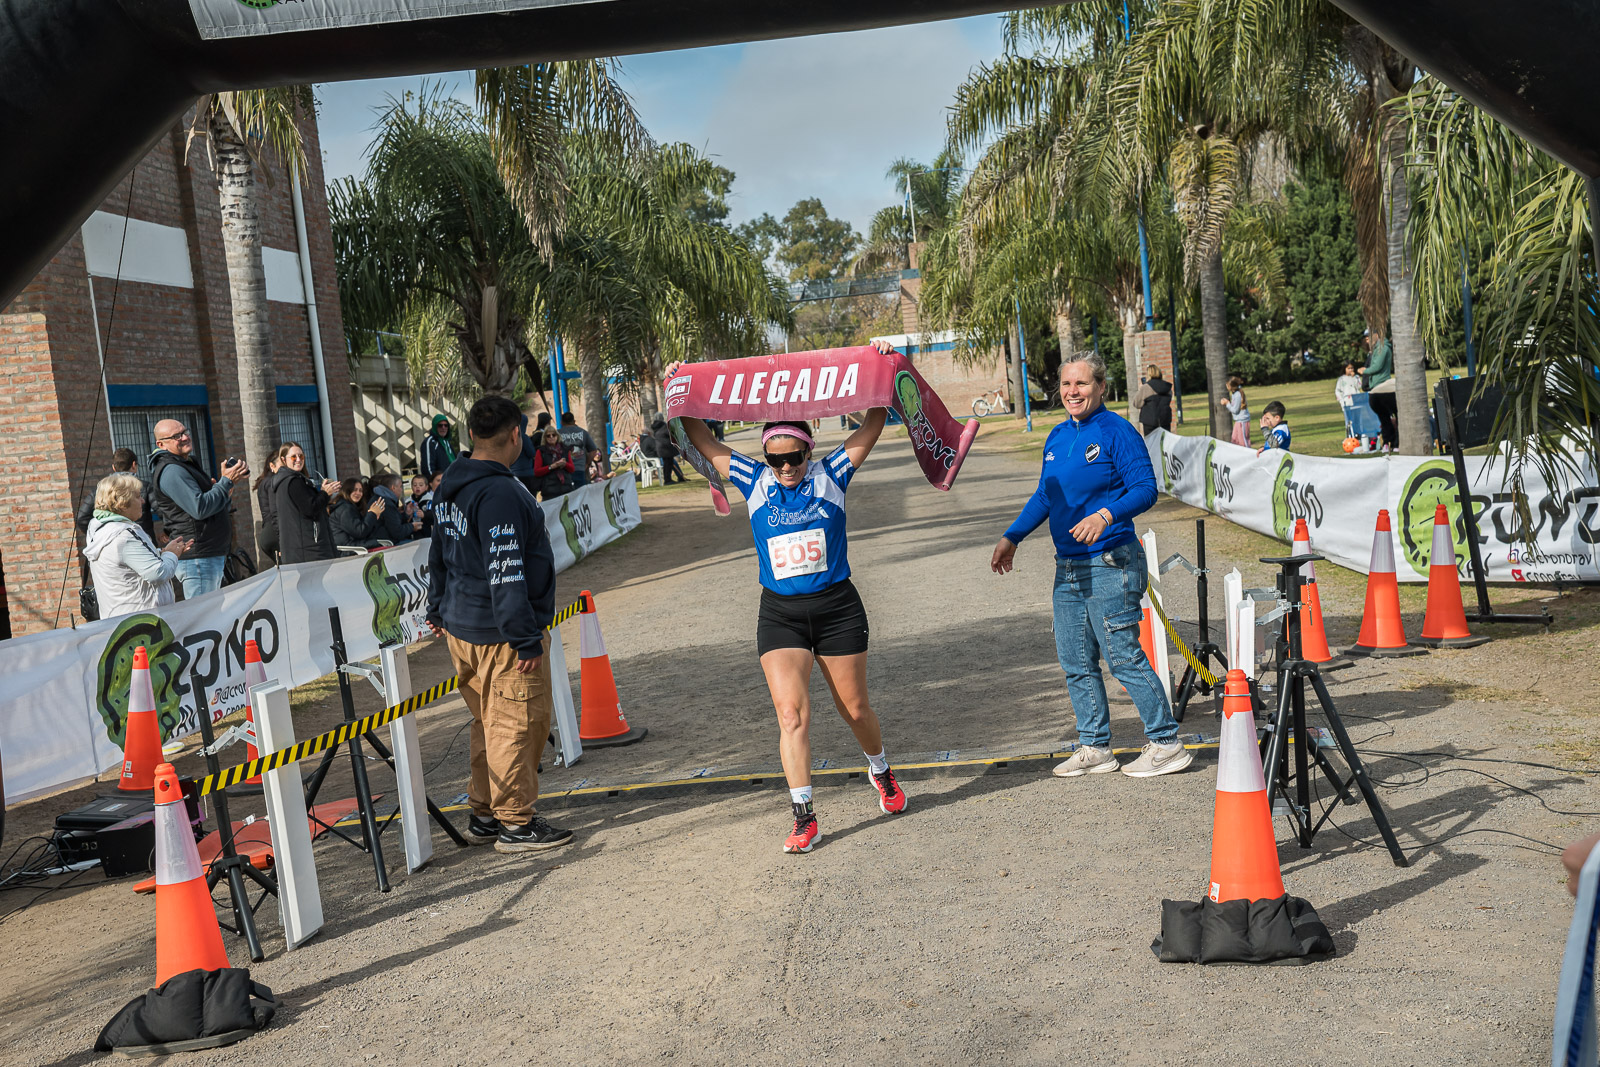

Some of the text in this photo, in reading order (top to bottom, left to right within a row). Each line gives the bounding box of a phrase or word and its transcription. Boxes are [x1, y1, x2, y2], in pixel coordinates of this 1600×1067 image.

[709, 363, 860, 405] LLEGADA
[501, 523, 516, 536] club
[774, 540, 822, 568] 505
